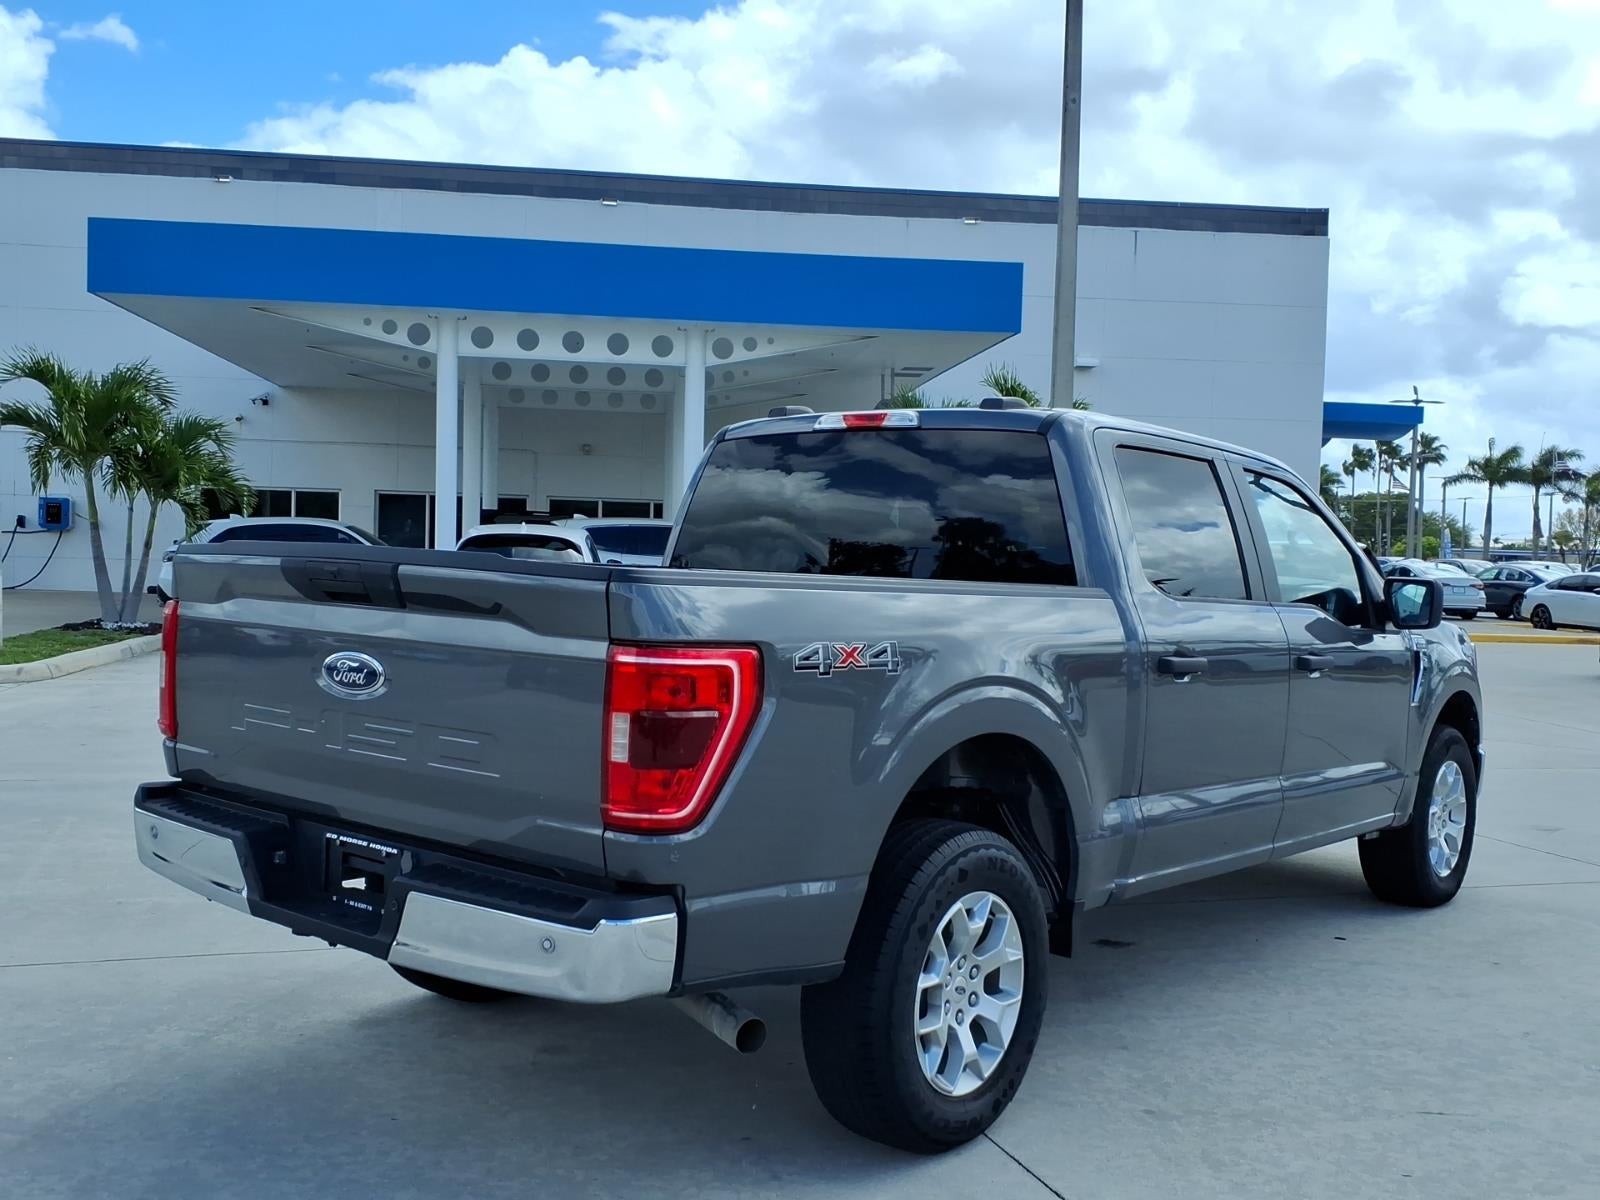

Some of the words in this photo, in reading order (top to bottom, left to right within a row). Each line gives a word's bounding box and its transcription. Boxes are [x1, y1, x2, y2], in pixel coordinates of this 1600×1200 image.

[333, 659, 368, 685] Ford
[231, 702, 500, 777] F-150
[339, 835, 368, 847] MORSE
[370, 842, 398, 854] HONDA
